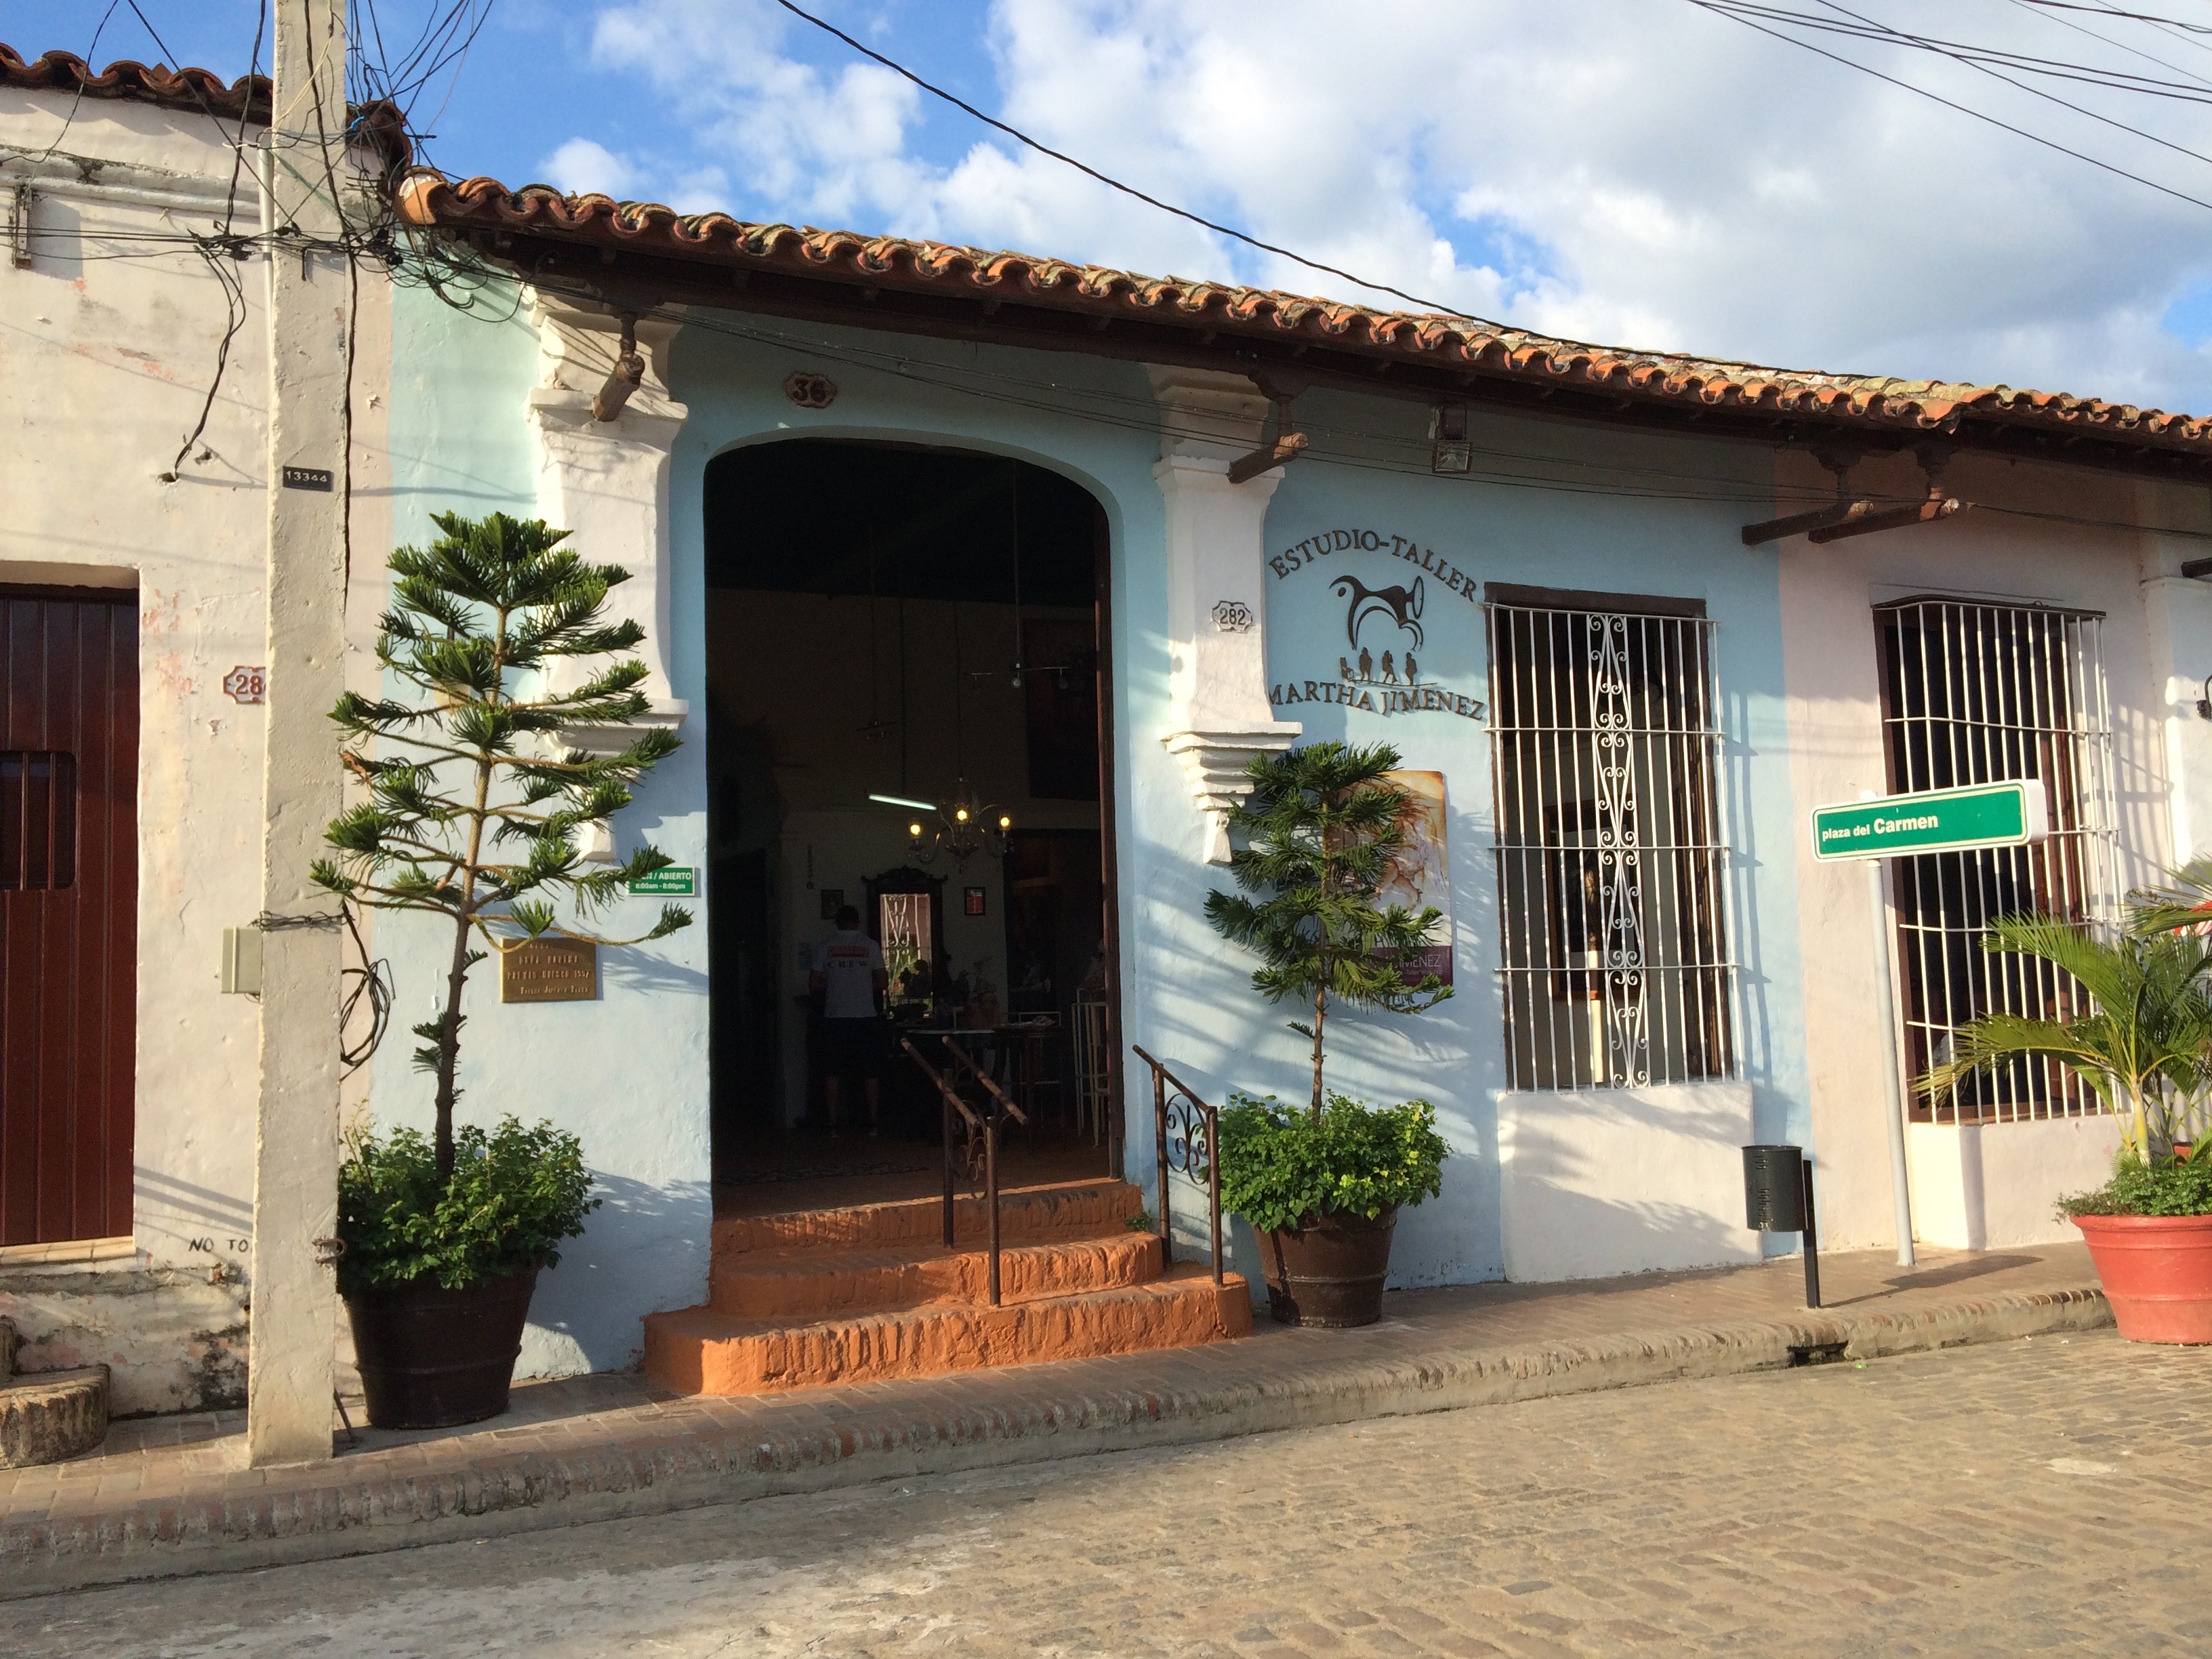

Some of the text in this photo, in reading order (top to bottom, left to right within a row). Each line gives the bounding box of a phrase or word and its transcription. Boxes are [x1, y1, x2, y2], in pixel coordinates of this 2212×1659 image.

[285, 470, 327, 483] 13344
[1269, 529, 1477, 602] ESTUDIO-TALLER
[1219, 607, 1246, 626] 282
[235, 674, 266, 695] 28
[1268, 680, 1485, 721] MARTHA JIMENEZ
[1822, 814, 1939, 842] plaza del Carmen
[658, 872, 692, 880] ABIERTO
[188, 1237, 252, 1252] NO TO
